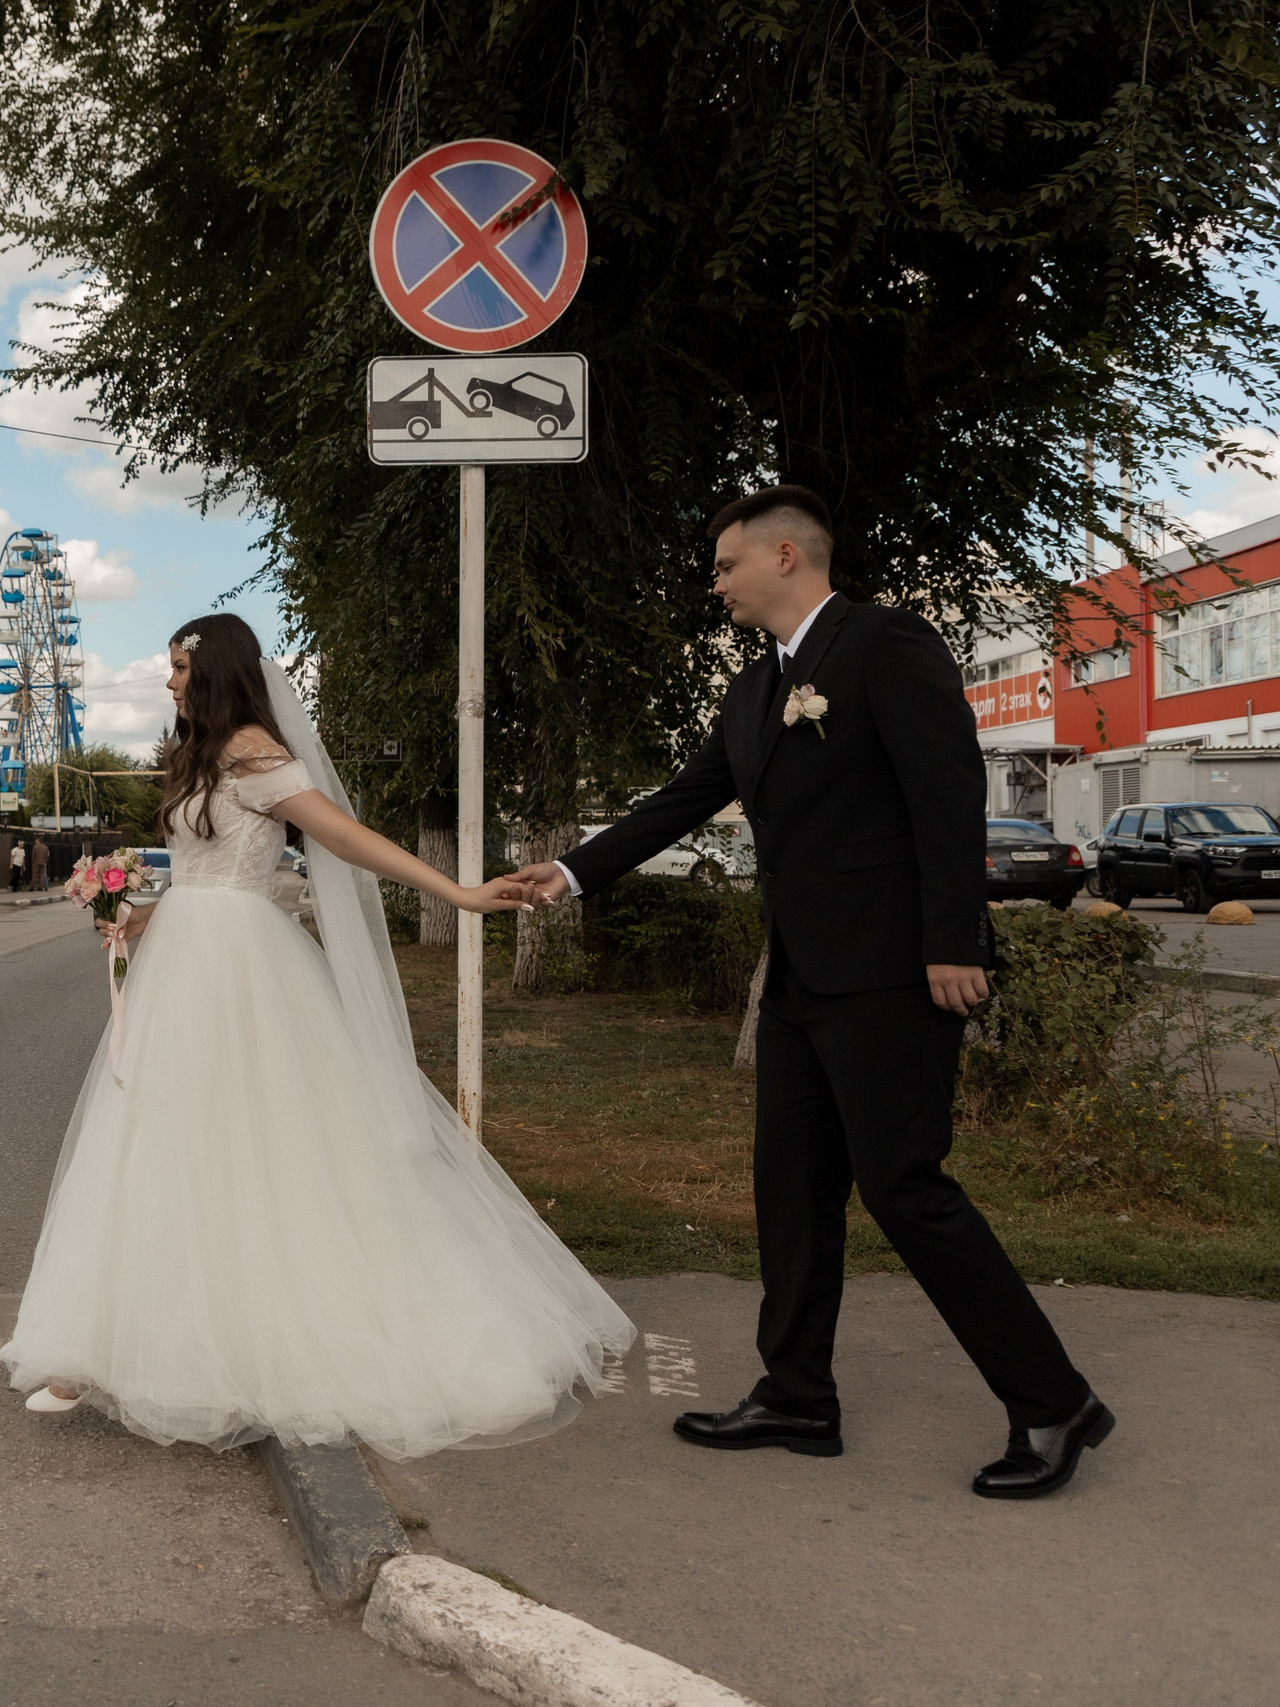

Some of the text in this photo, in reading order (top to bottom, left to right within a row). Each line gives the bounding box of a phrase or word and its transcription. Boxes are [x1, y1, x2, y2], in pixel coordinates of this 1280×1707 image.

[971, 692, 1032, 724] арт 2 этаж
